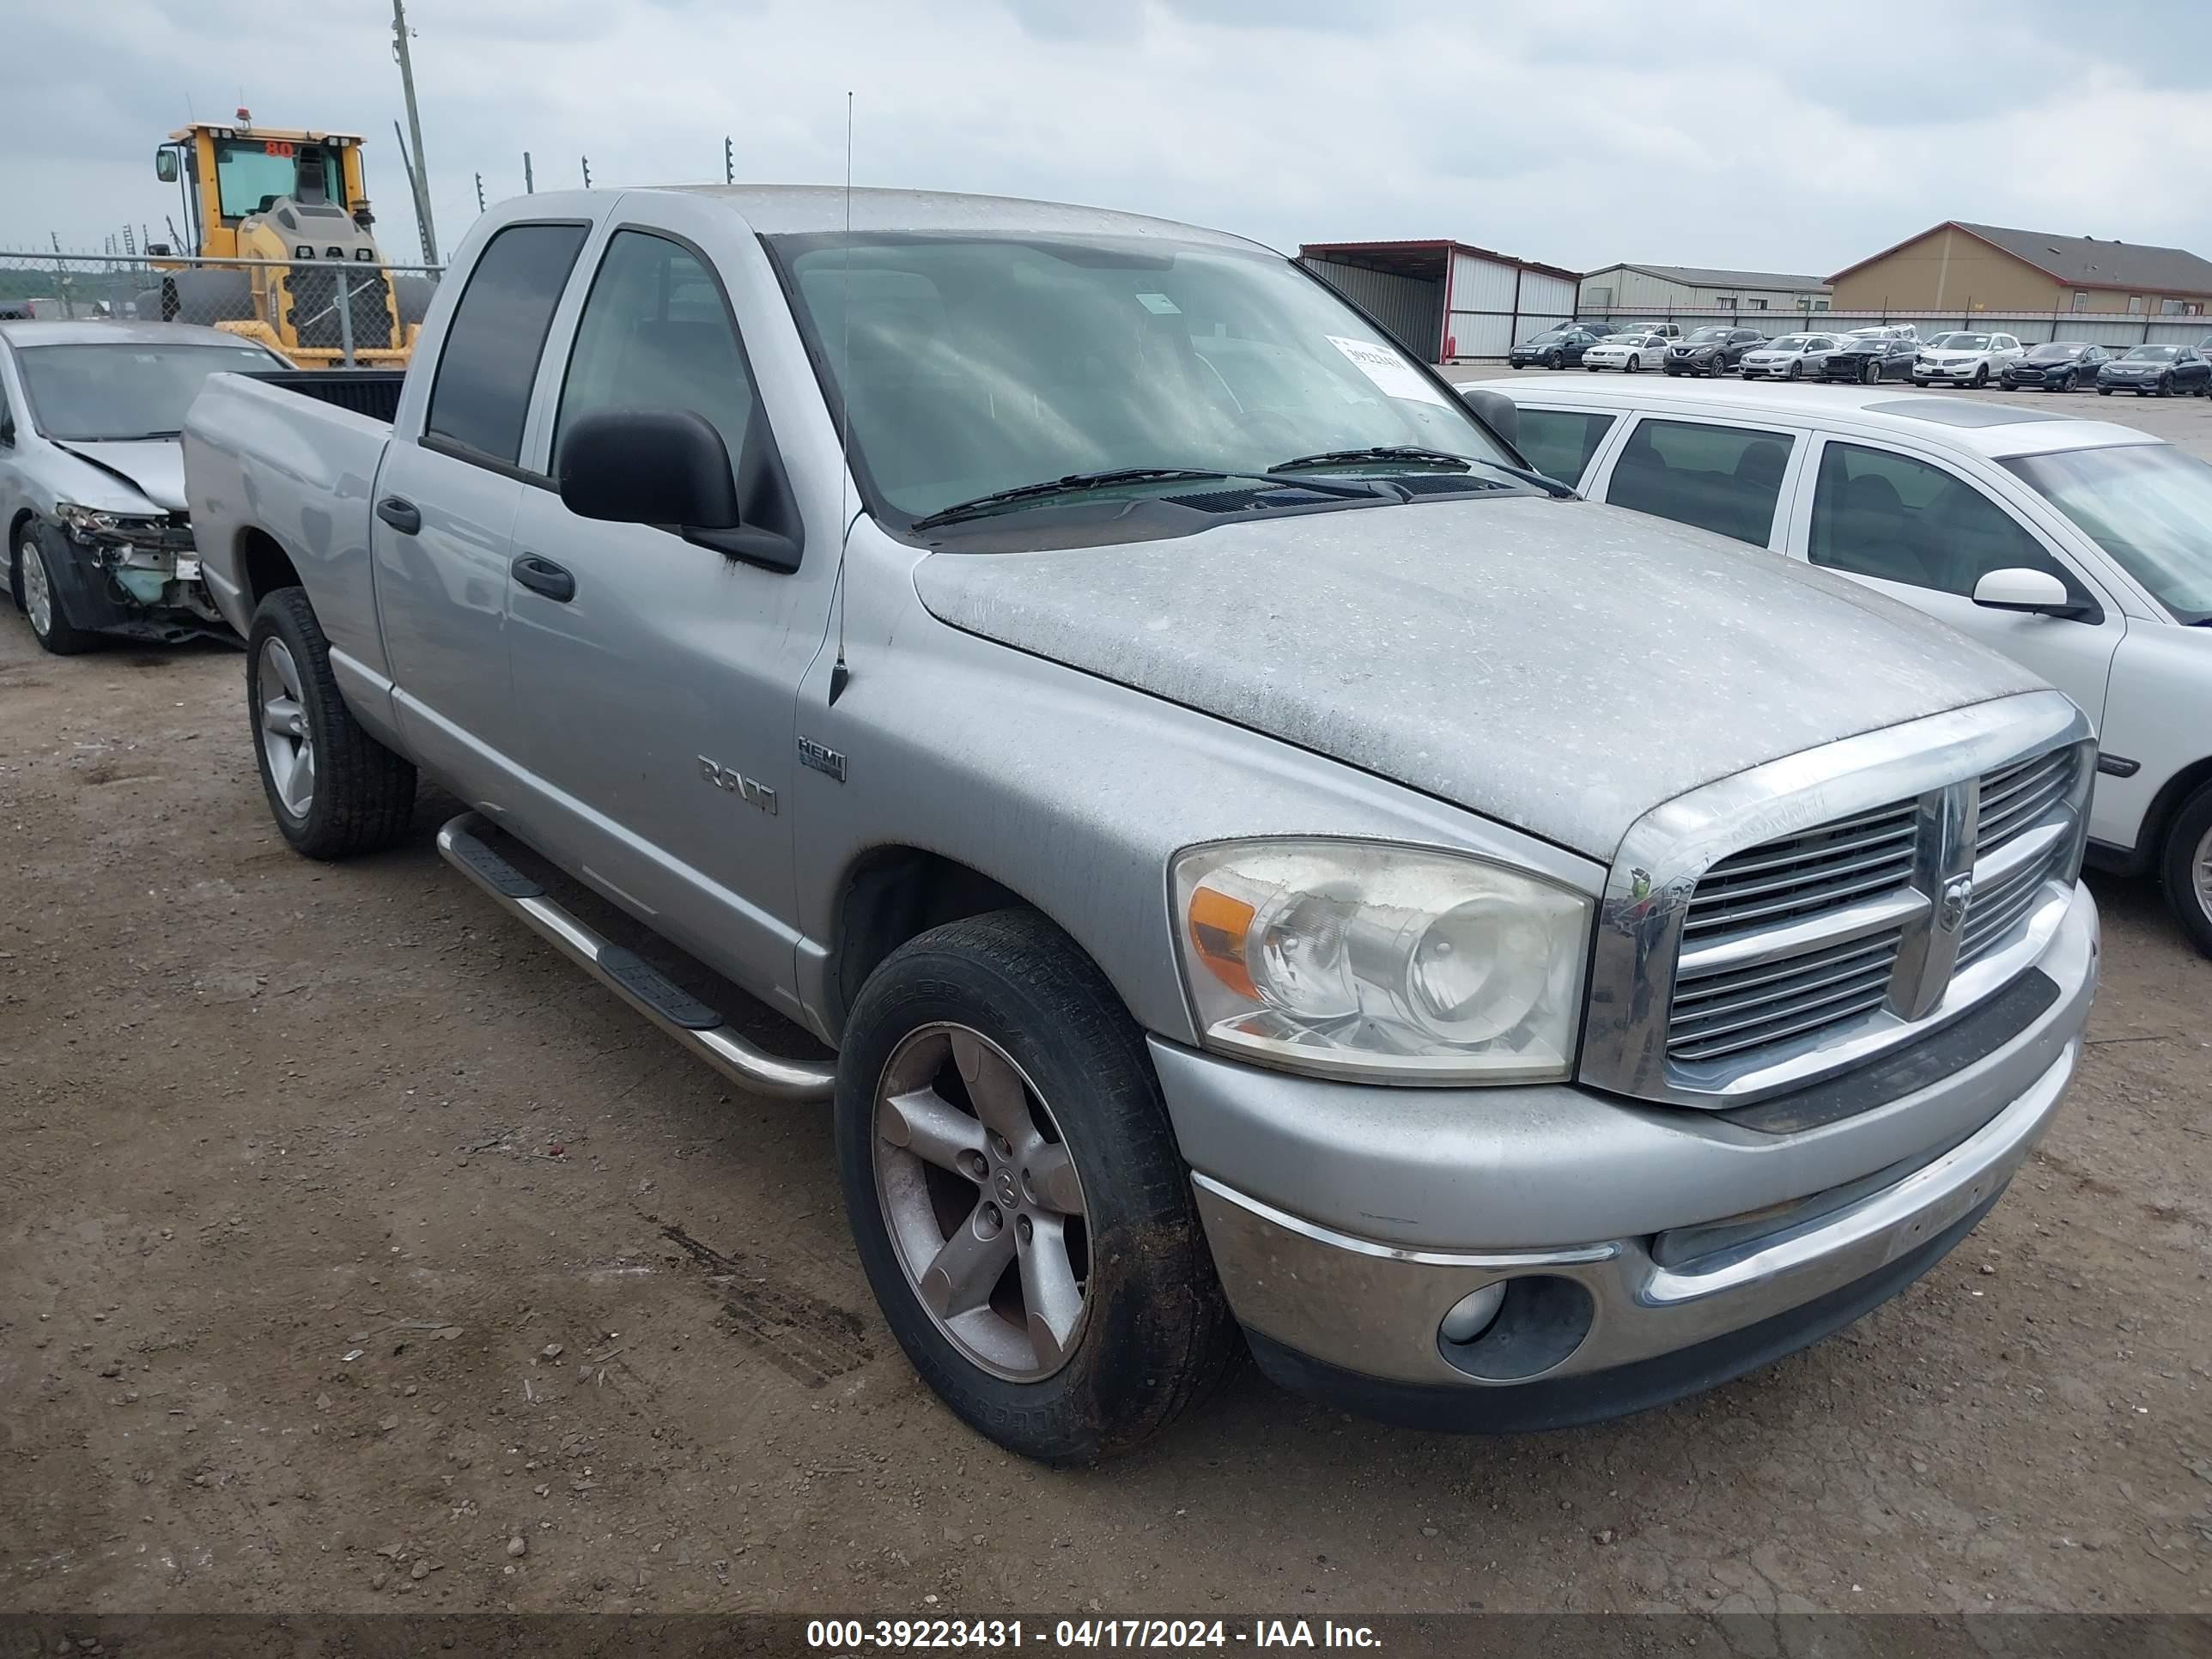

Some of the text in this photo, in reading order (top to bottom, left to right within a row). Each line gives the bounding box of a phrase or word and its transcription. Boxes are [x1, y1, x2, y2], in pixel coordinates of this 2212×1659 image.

[264, 141, 293, 158] 80
[798, 735, 847, 770] HEMI
[697, 754, 778, 816] RAM
